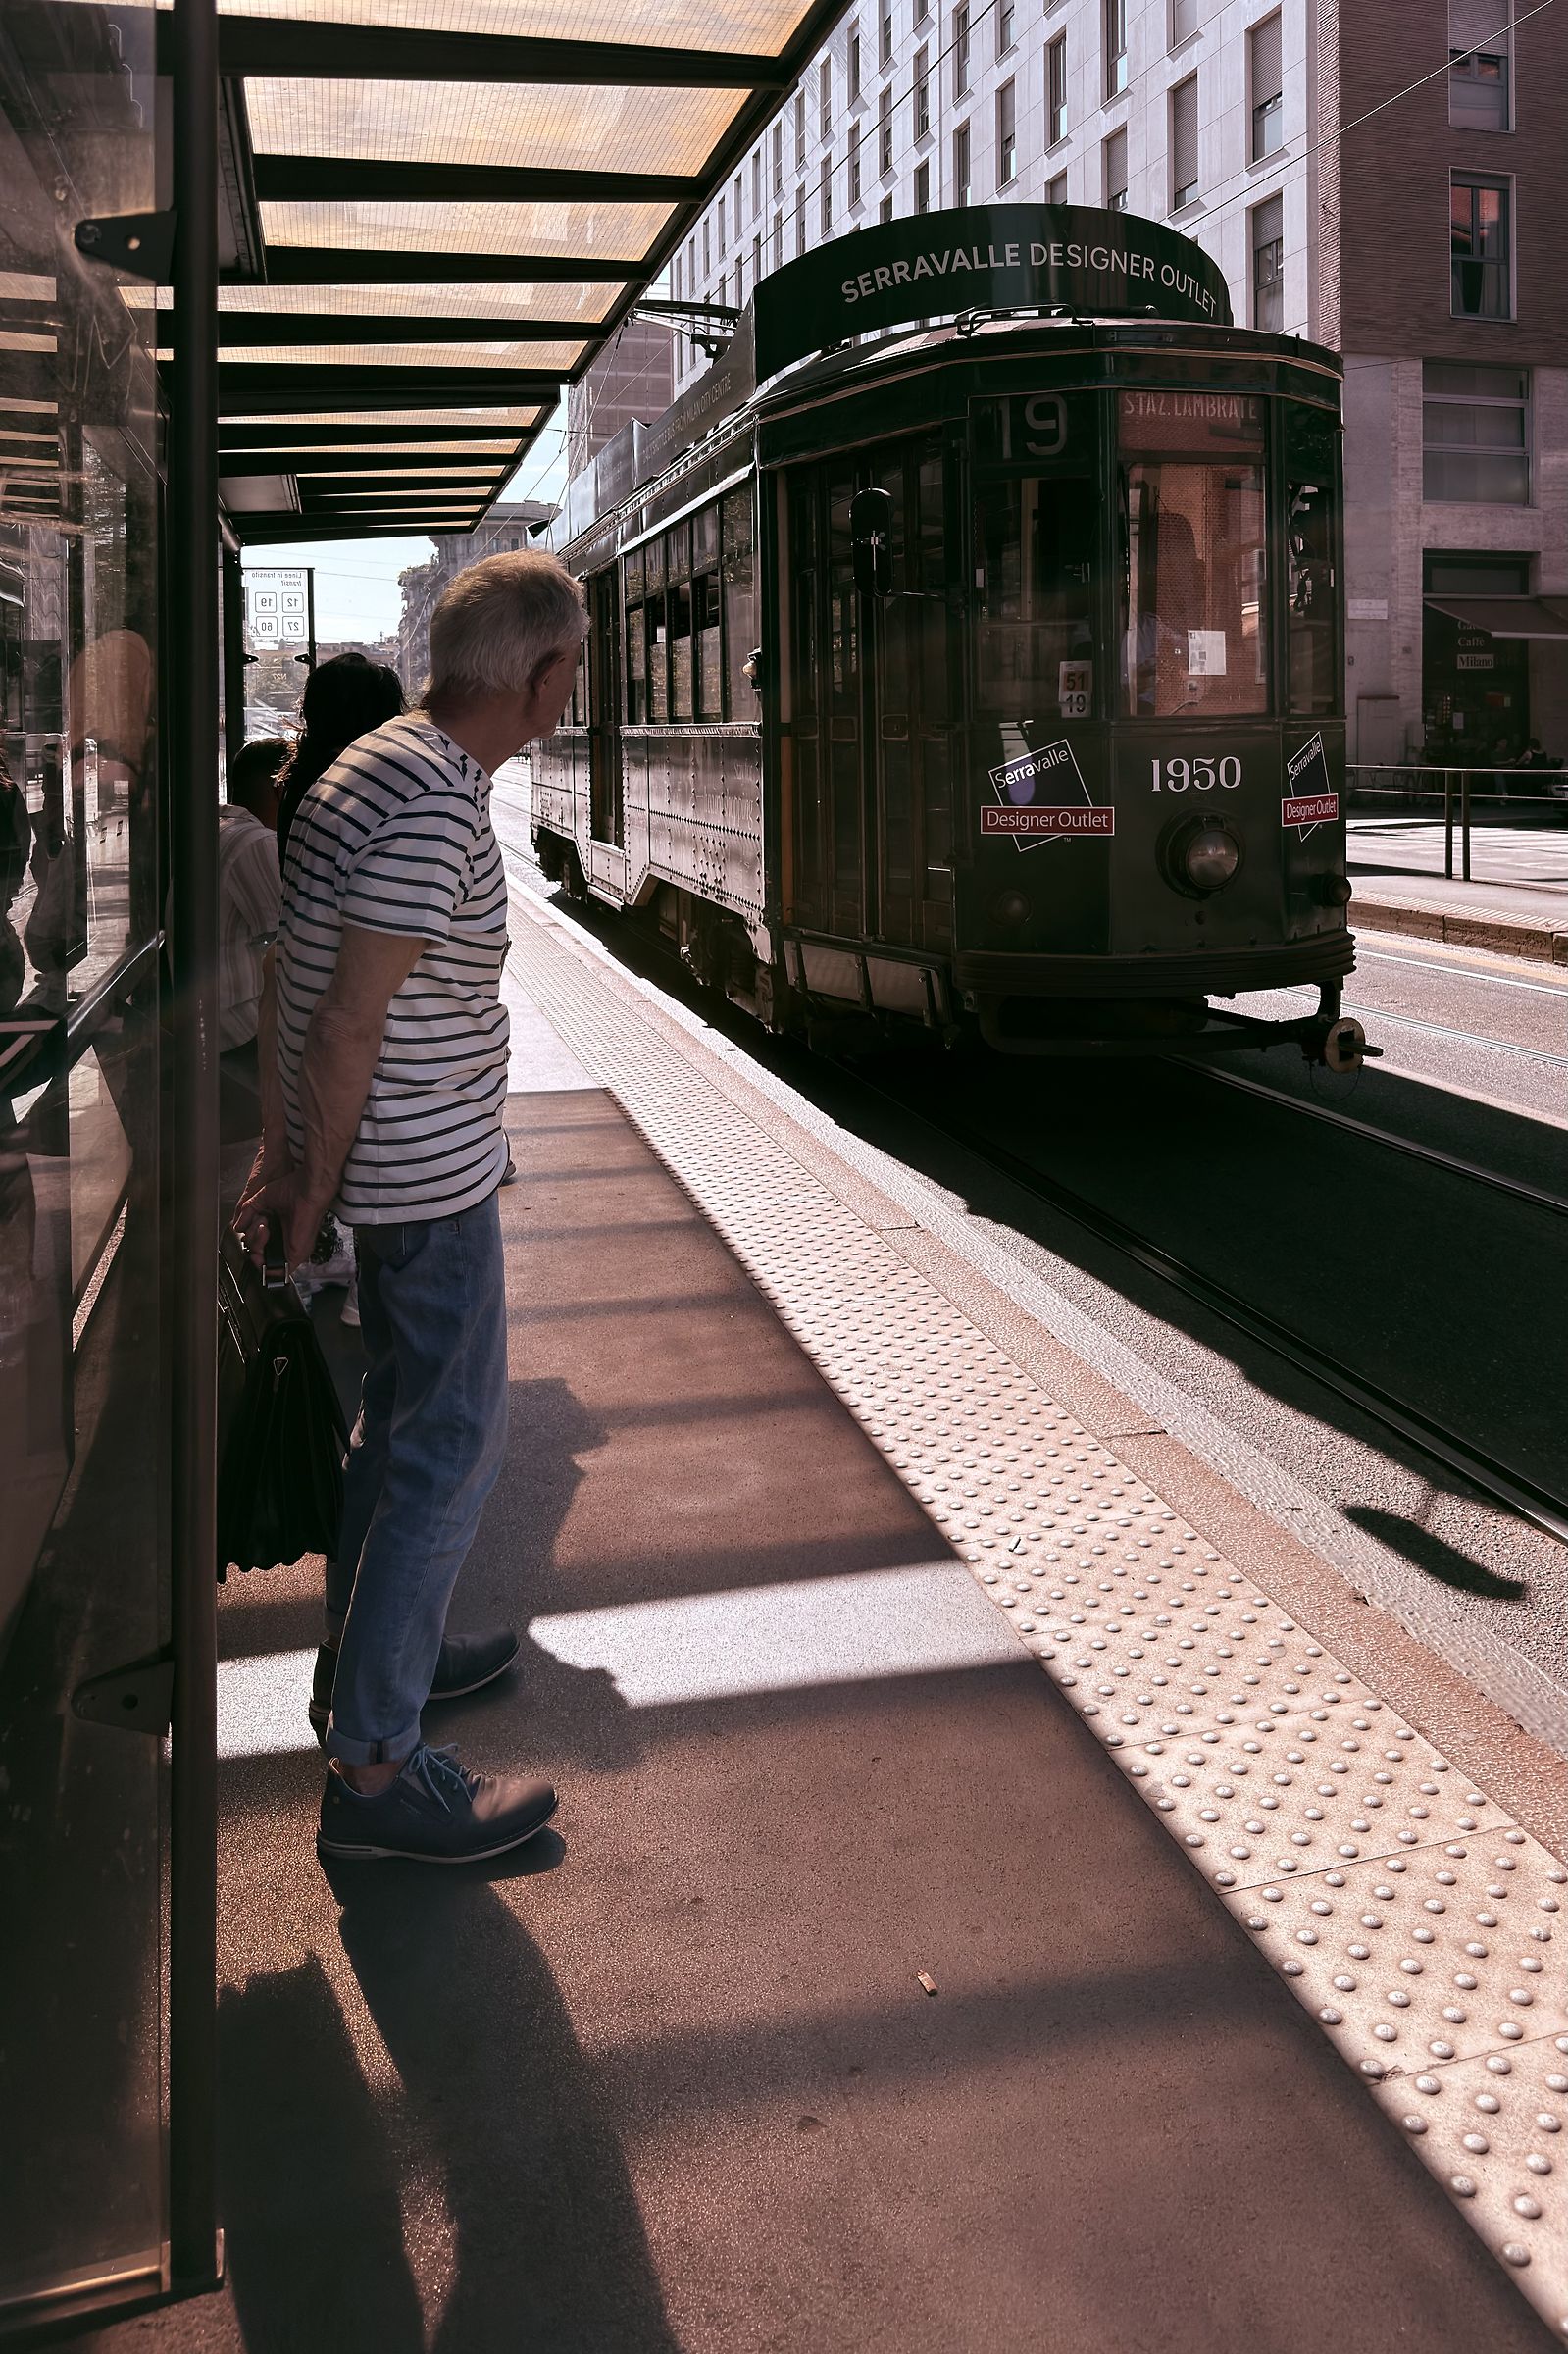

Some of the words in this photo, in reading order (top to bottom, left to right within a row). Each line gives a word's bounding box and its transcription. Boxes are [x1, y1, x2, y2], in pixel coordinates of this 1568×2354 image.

[841, 243, 1021, 303] SERRAVALLE
[1030, 243, 1155, 281] DESIGNER
[1160, 264, 1218, 317] OUTLET
[701, 391, 712, 413] CITY
[711, 372, 731, 404] CENTRE
[1174, 394, 1257, 419] LAMBRATE
[998, 393, 1068, 459] 19
[1459, 656, 1492, 667] Milano
[1066, 672, 1085, 691] 51
[1066, 694, 1086, 713] 19
[995, 749, 1069, 788] Serravalle
[1151, 756, 1241, 792] 1950
[1290, 742, 1321, 780] Serravalle
[987, 811, 1055, 831] Designer
[1058, 811, 1108, 828] Outlet
[1287, 803, 1316, 821] Designer
[1316, 799, 1336, 815] Outlet
